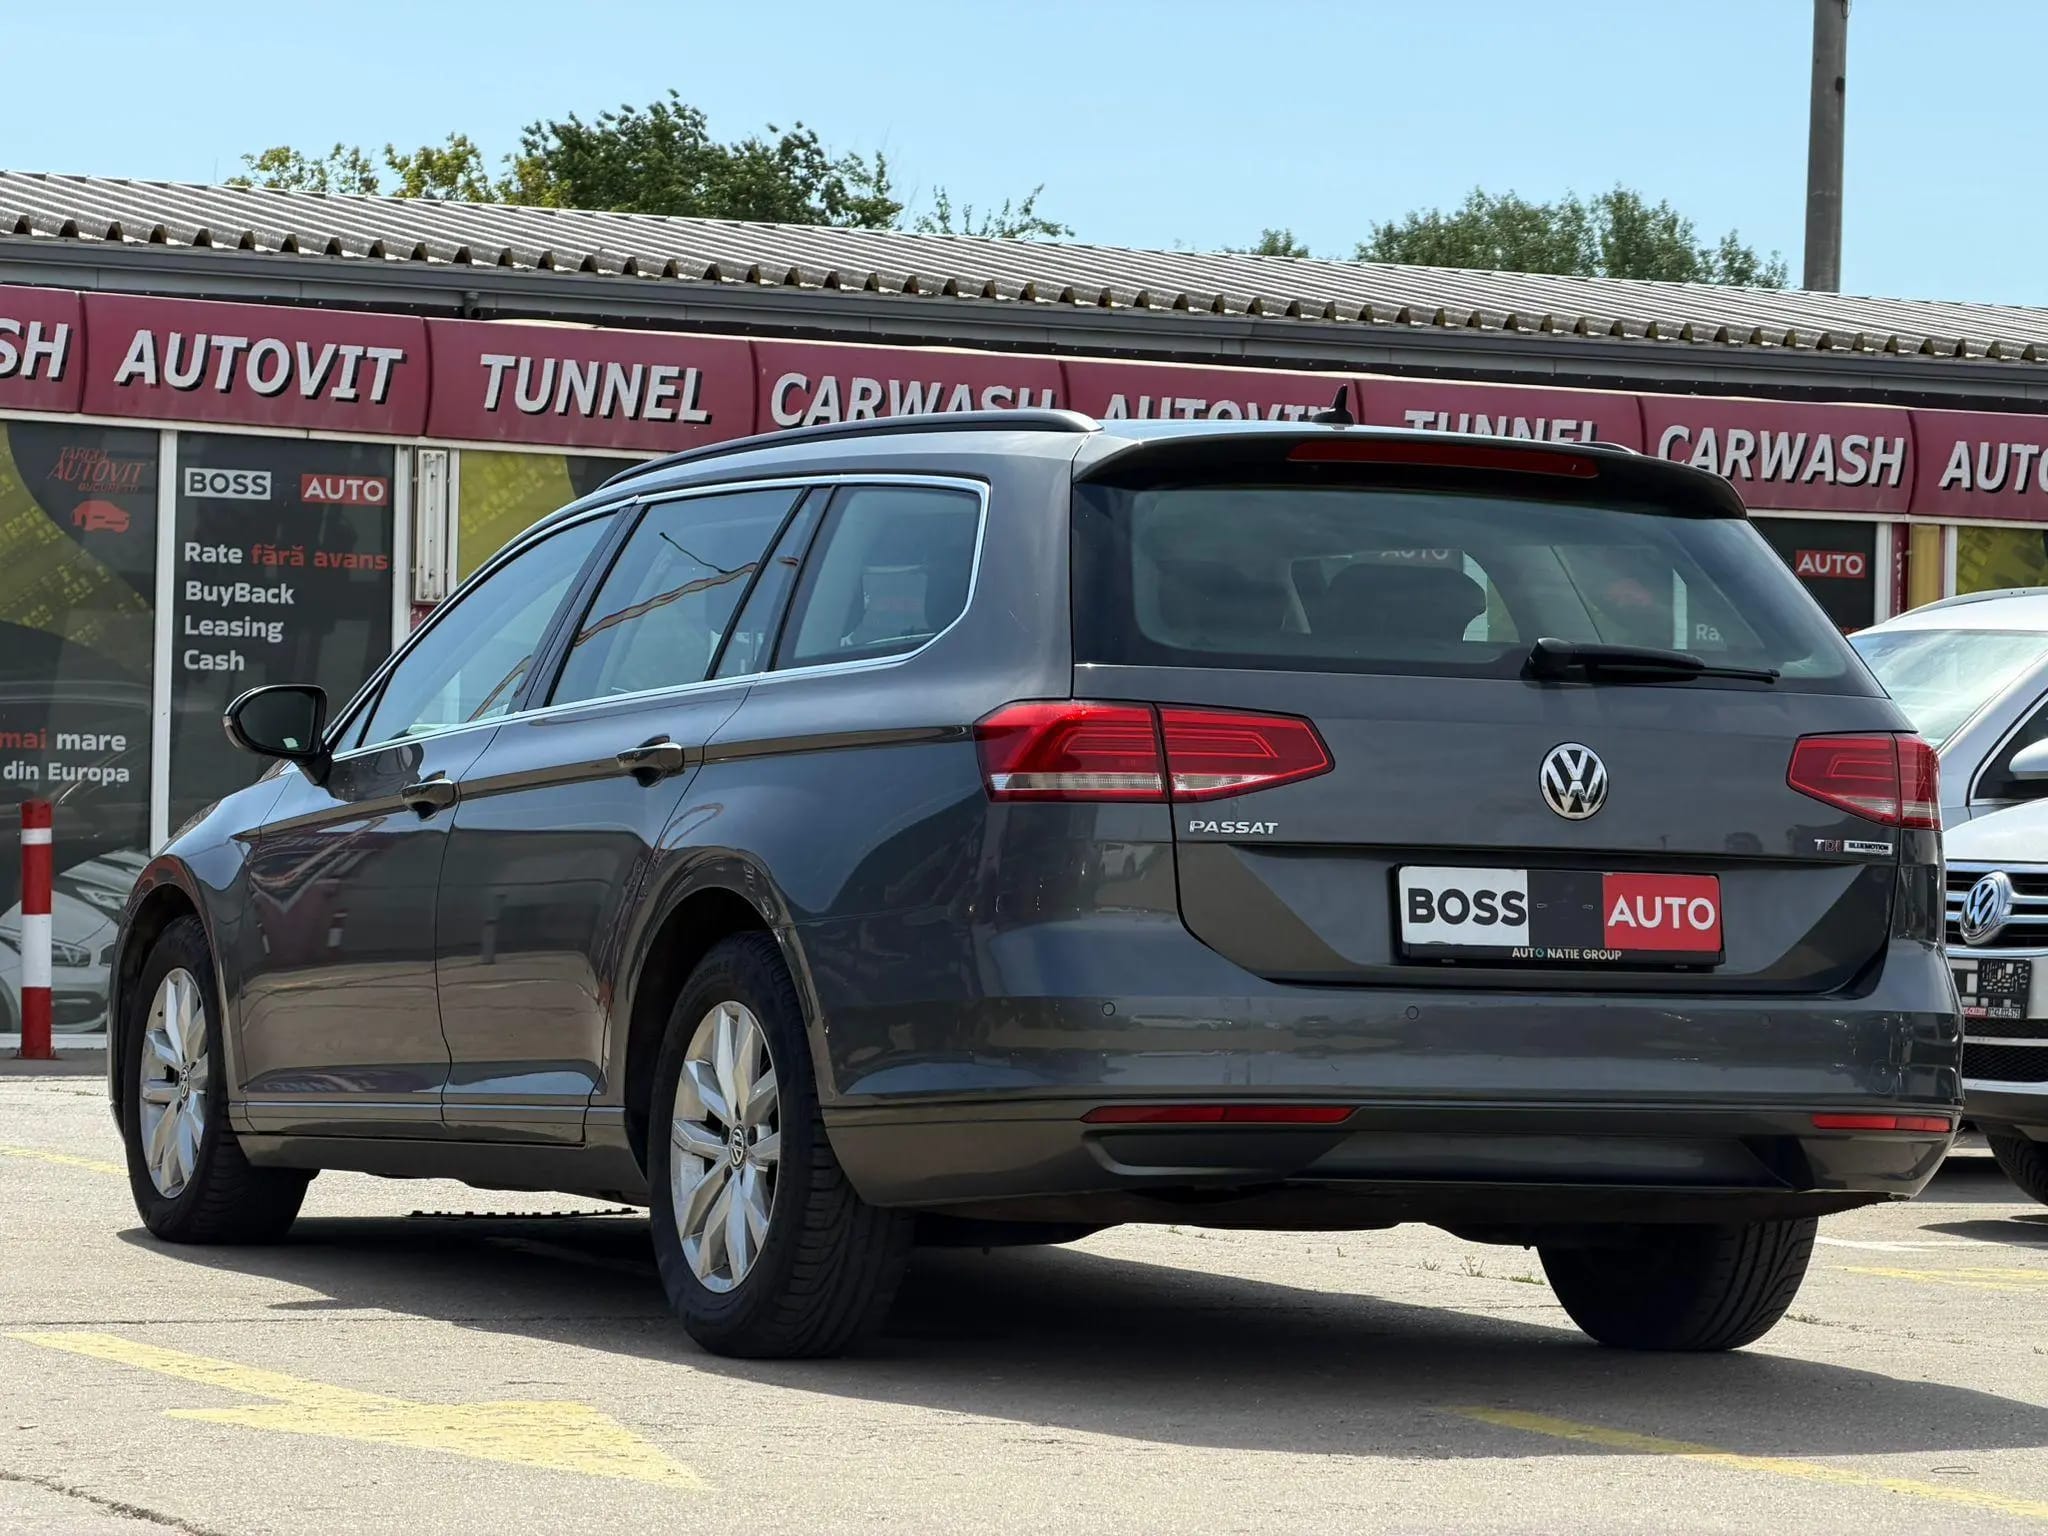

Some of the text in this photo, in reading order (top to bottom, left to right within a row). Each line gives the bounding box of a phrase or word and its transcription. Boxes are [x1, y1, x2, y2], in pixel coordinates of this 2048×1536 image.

[113, 328, 404, 402] AUTOVIT
[479, 353, 709, 422] TUNNEL
[1658, 424, 1905, 486] CARWASH
[47, 459, 147, 482] AUTOVIT
[189, 472, 385, 502] BOSS AUTO
[184, 541, 388, 571] Rate fără avans
[1798, 553, 1863, 575] AUTO
[185, 580, 295, 607] BuyBack
[184, 614, 284, 643] Leasing
[183, 649, 245, 671] Cash
[0, 727, 127, 752] mai mare
[3, 760, 130, 787] din Europa
[1189, 820, 1279, 835] PASSAT
[1814, 838, 1841, 853] TDI
[1407, 887, 1716, 931] BOSS AUTO
[1512, 947, 1622, 961] AUTO NATIE GROUP
